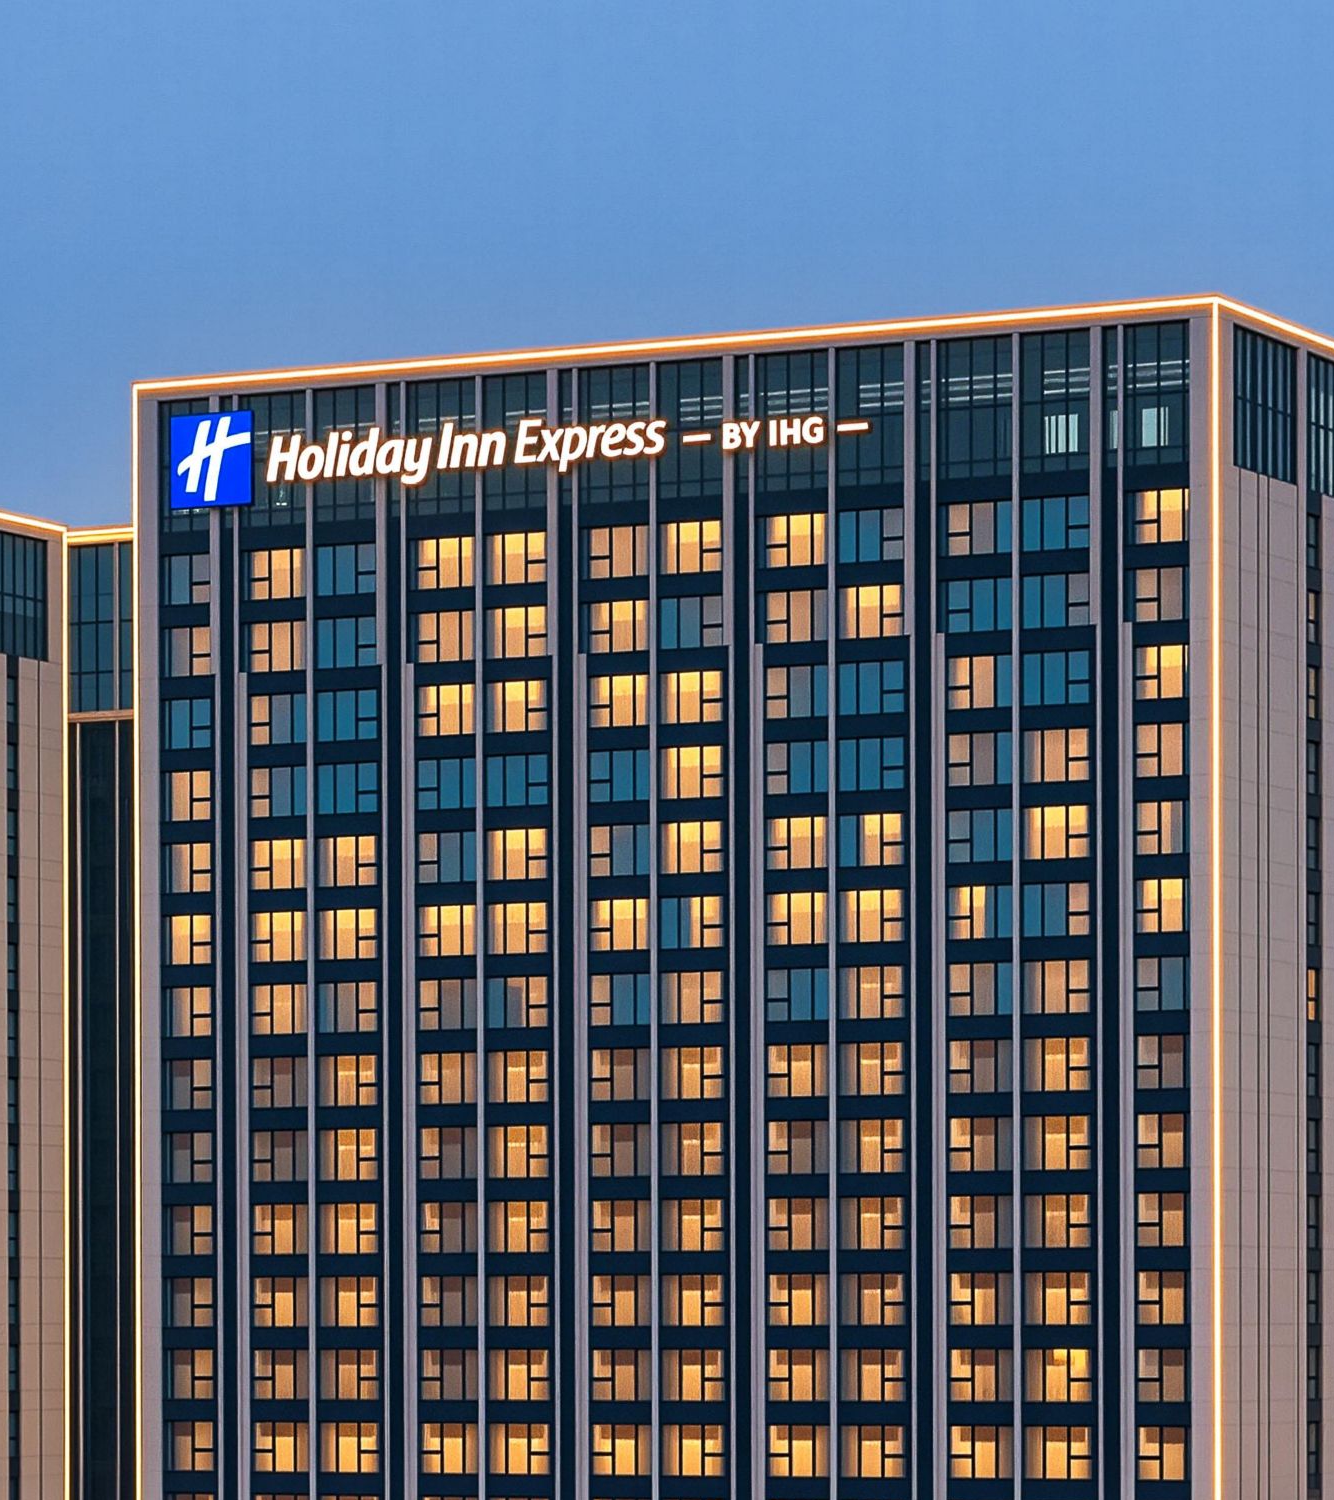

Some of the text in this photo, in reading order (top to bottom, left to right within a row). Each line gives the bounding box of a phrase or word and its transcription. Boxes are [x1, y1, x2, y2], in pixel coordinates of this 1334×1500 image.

[265, 418, 668, 485] Holiday Inn Express
[721, 416, 825, 450] BY IHG
